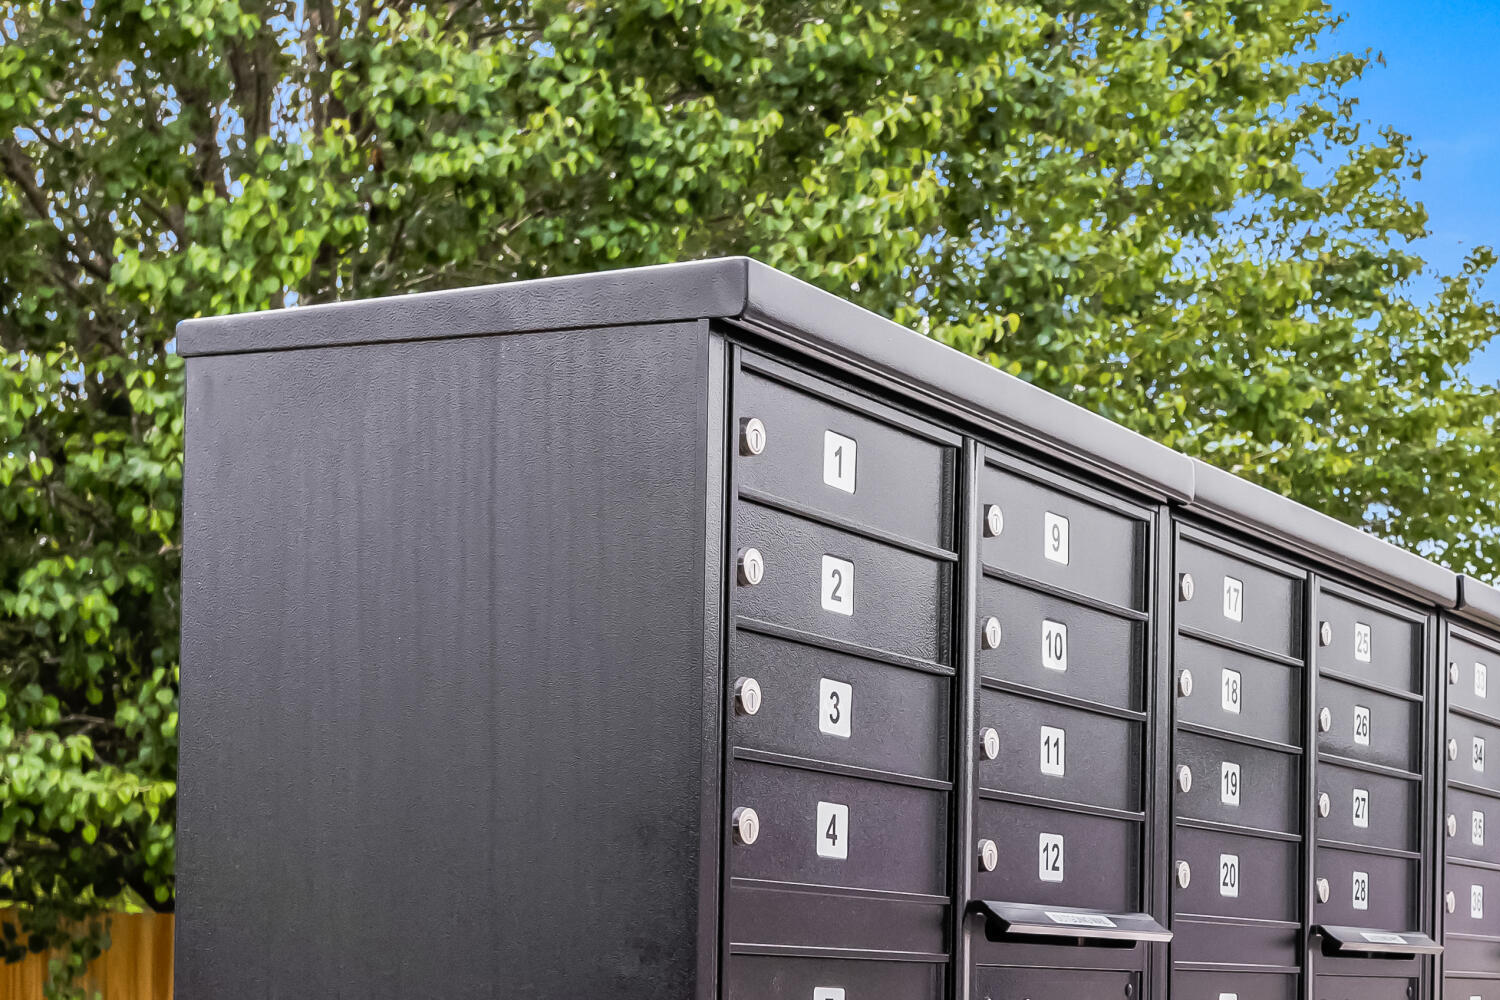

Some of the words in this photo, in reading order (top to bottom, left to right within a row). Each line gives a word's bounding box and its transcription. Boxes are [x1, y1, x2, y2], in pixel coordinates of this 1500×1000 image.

[834, 445, 843, 479] 1
[1051, 523, 1061, 552] 9
[830, 568, 842, 603] 2
[1226, 585, 1240, 613] 17
[1045, 630, 1063, 661] 10
[1356, 630, 1369, 655] 25
[1225, 677, 1238, 705] 18
[829, 691, 840, 725] 3
[1355, 713, 1368, 737] 26
[1044, 735, 1060, 766] 11
[1474, 743, 1483, 765] 34
[1224, 770, 1238, 797] 19
[1354, 796, 1366, 819] 27
[825, 813, 838, 847] 4
[1473, 817, 1482, 839] 35
[1042, 842, 1060, 872] 12
[1222, 862, 1236, 888] 20
[1354, 878, 1366, 902] 28
[1472, 891, 1481, 912] 36
